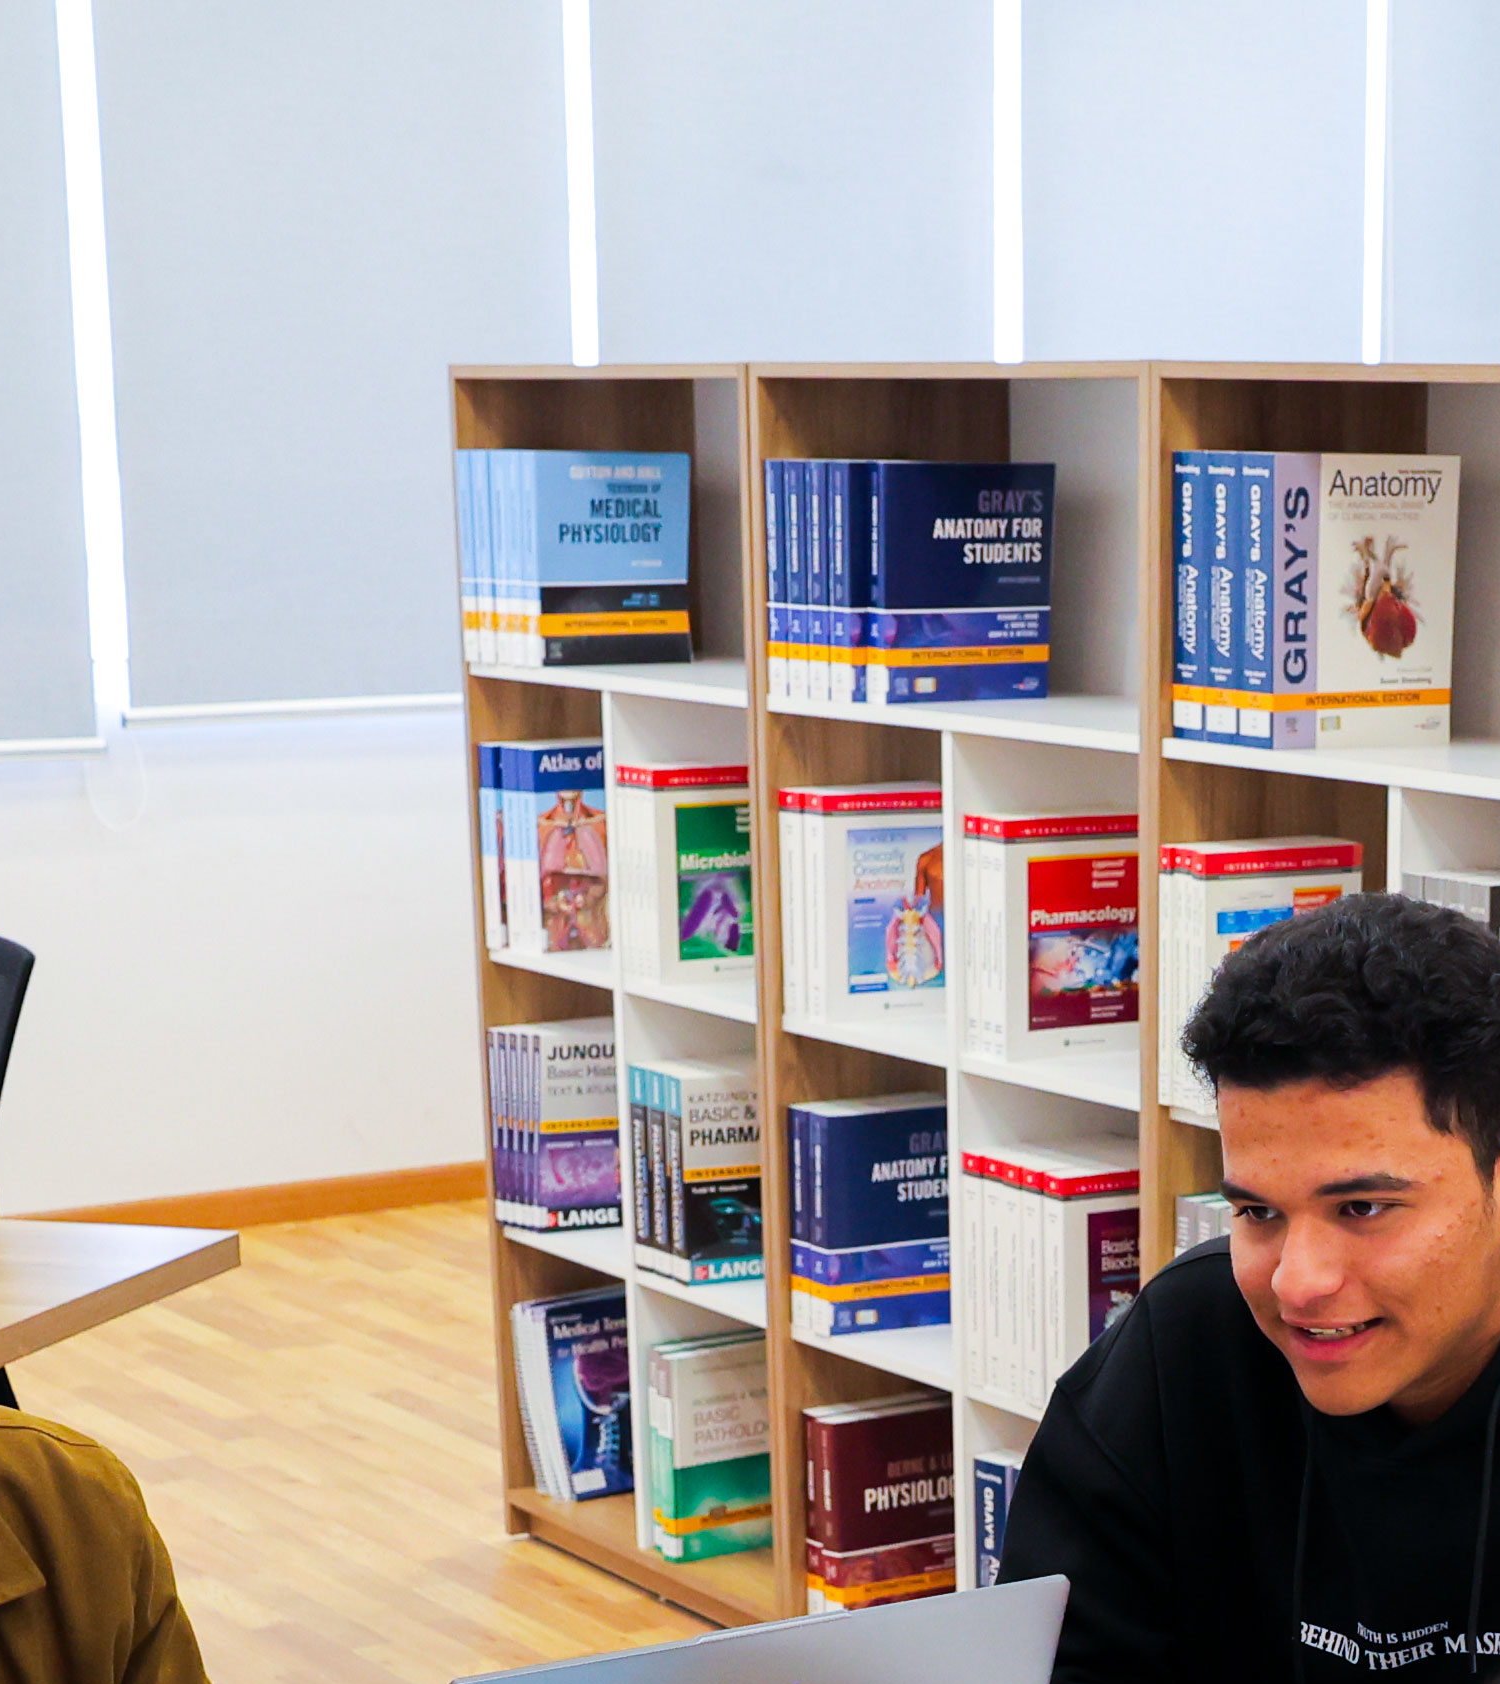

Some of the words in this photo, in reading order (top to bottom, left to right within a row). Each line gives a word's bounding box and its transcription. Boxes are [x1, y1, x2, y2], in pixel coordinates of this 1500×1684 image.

[1329, 470, 1442, 503] Anatomy
[590, 499, 662, 518] MEDICAL
[978, 490, 1043, 513] GRAY'S
[933, 518, 1008, 539] ANATOMY
[1012, 518, 1042, 538] FOR
[1181, 481, 1192, 557] GRAY'S
[1250, 484, 1261, 562] GRAY'S
[559, 524, 660, 543] PHYSIOLOGY
[963, 543, 1042, 564] STUDENTS
[1283, 486, 1309, 684] GRAY'S
[1306, 693, 1379, 705] INTERNATIONAL
[1382, 692, 1420, 702] EDITION
[540, 754, 580, 773] Atlas
[1031, 906, 1136, 926] Pharmacology
[872, 1157, 937, 1182] ANATOMY
[558, 1208, 620, 1226] LANGE
[983, 1487, 994, 1550] GRAY'S
[1357, 1622, 1382, 1644] TRUTH
[1387, 1633, 1398, 1644] IS
[1402, 1621, 1448, 1642] HIDDEN
[1300, 1621, 1360, 1664] BEHIND
[1365, 1641, 1436, 1670] THEIR
